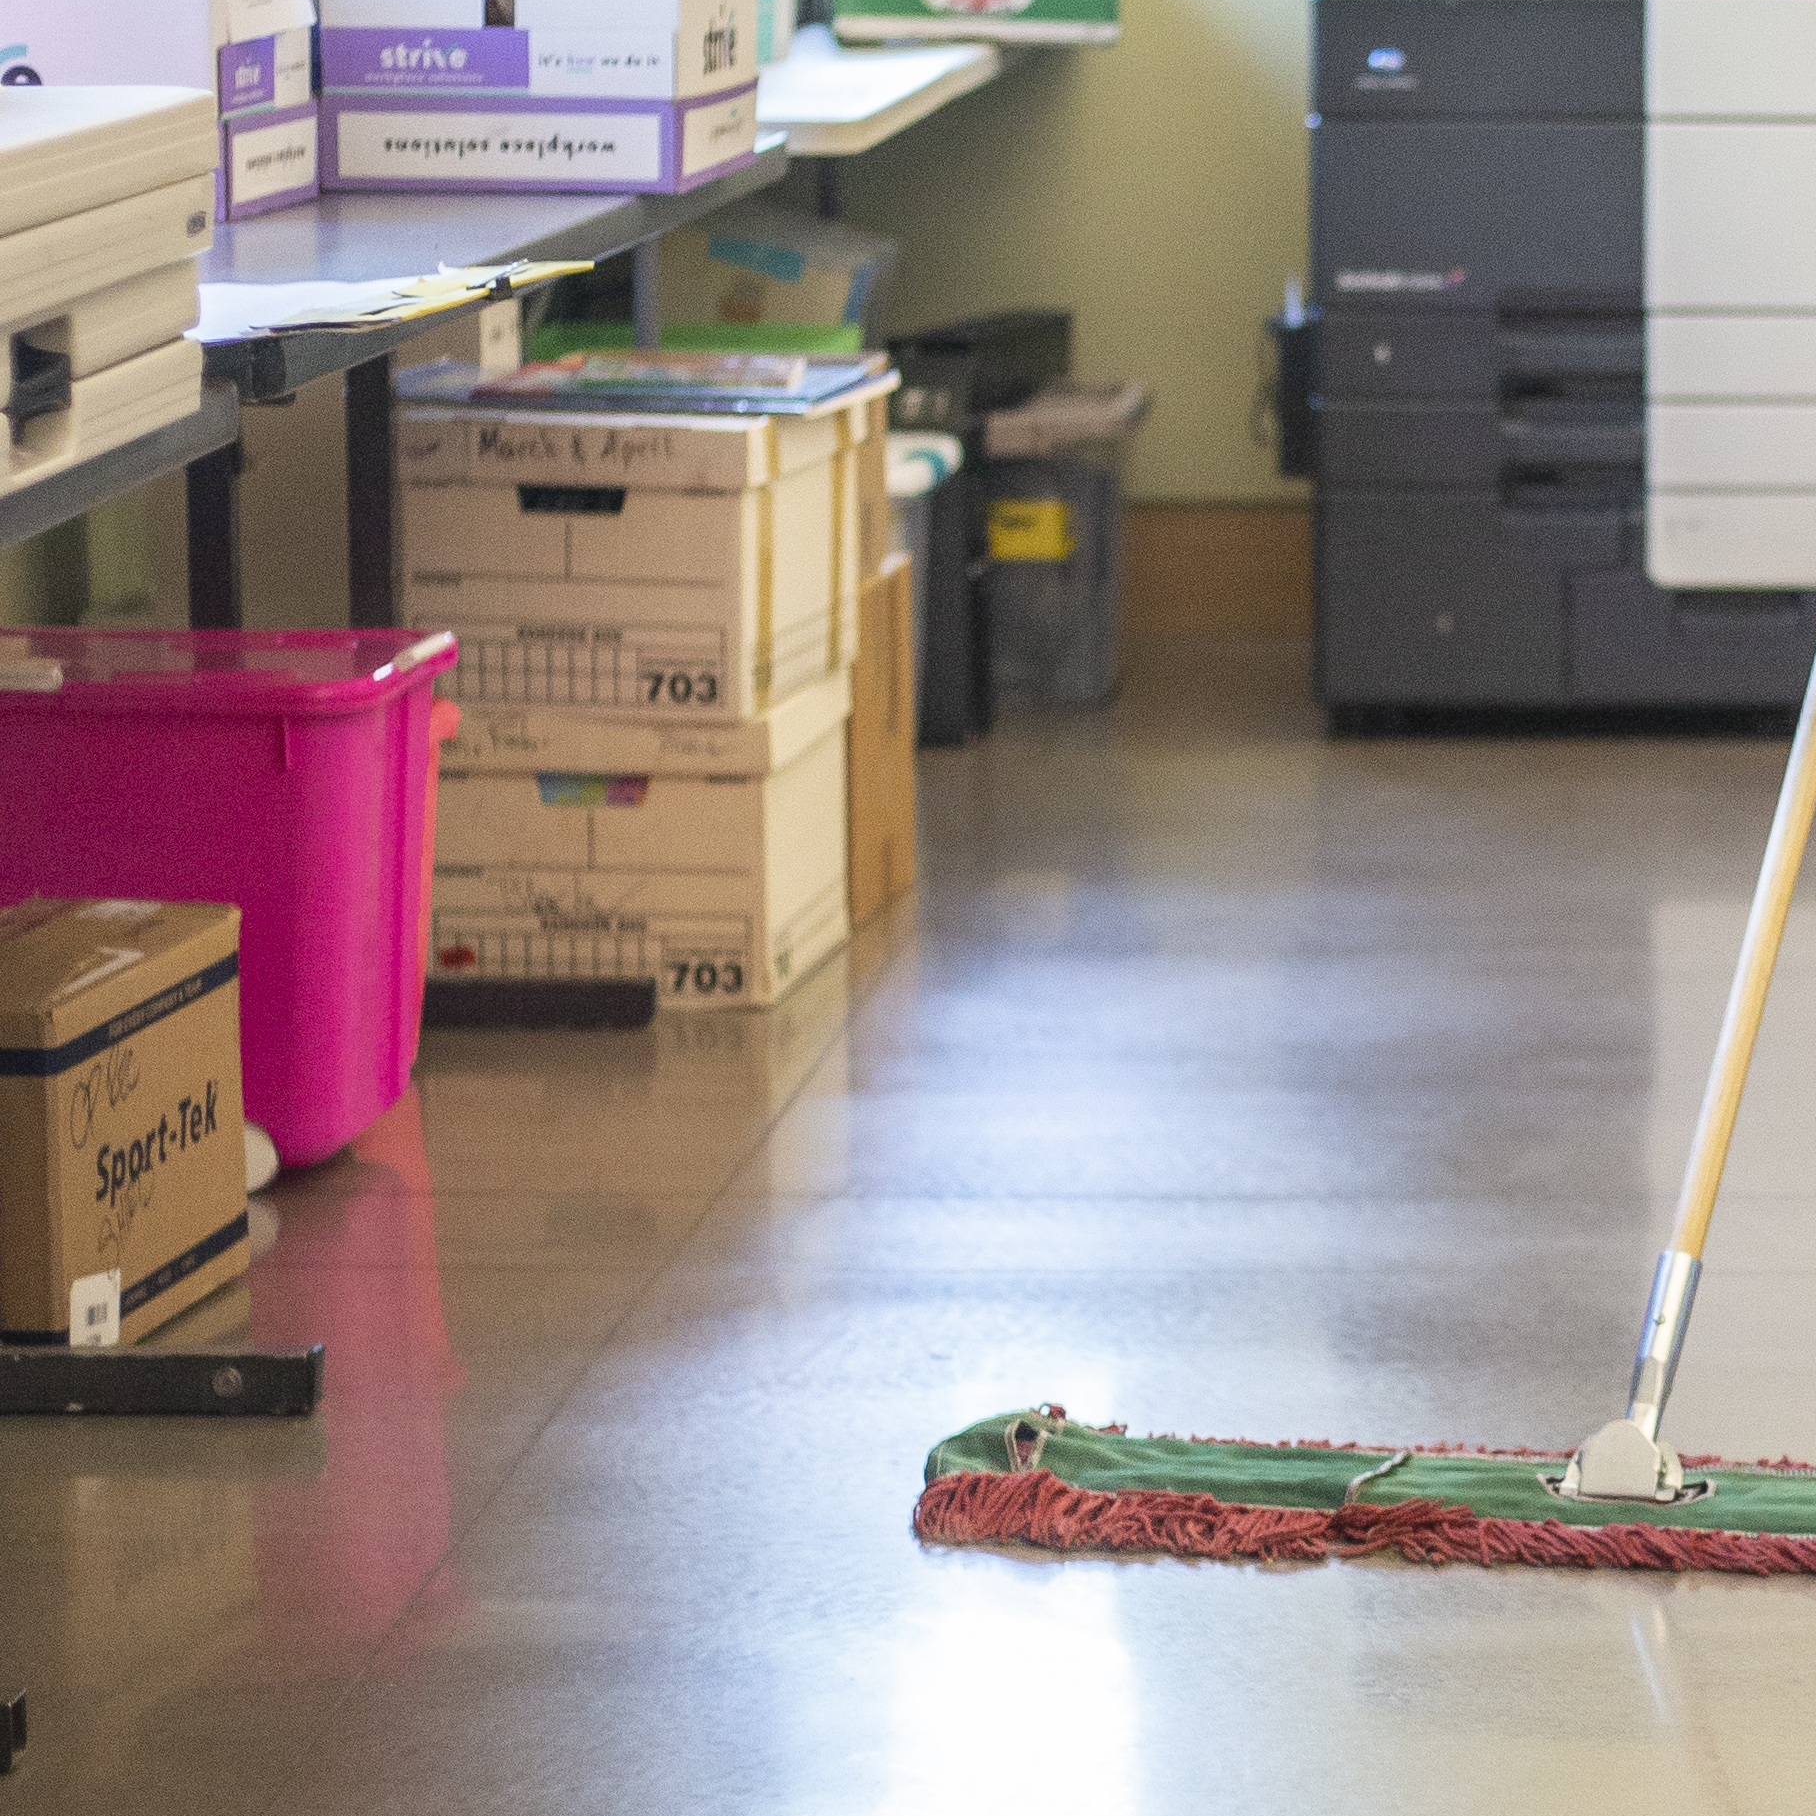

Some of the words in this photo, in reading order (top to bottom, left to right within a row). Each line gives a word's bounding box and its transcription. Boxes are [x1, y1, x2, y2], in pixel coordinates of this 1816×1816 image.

[379, 38, 469, 70] strive
[384, 138, 489, 159] solutions
[499, 133, 616, 161] workplace
[476, 428, 557, 461] March
[640, 672, 719, 704] 703
[670, 962, 745, 994] 703
[95, 1079, 219, 1209] Sport-Tek
